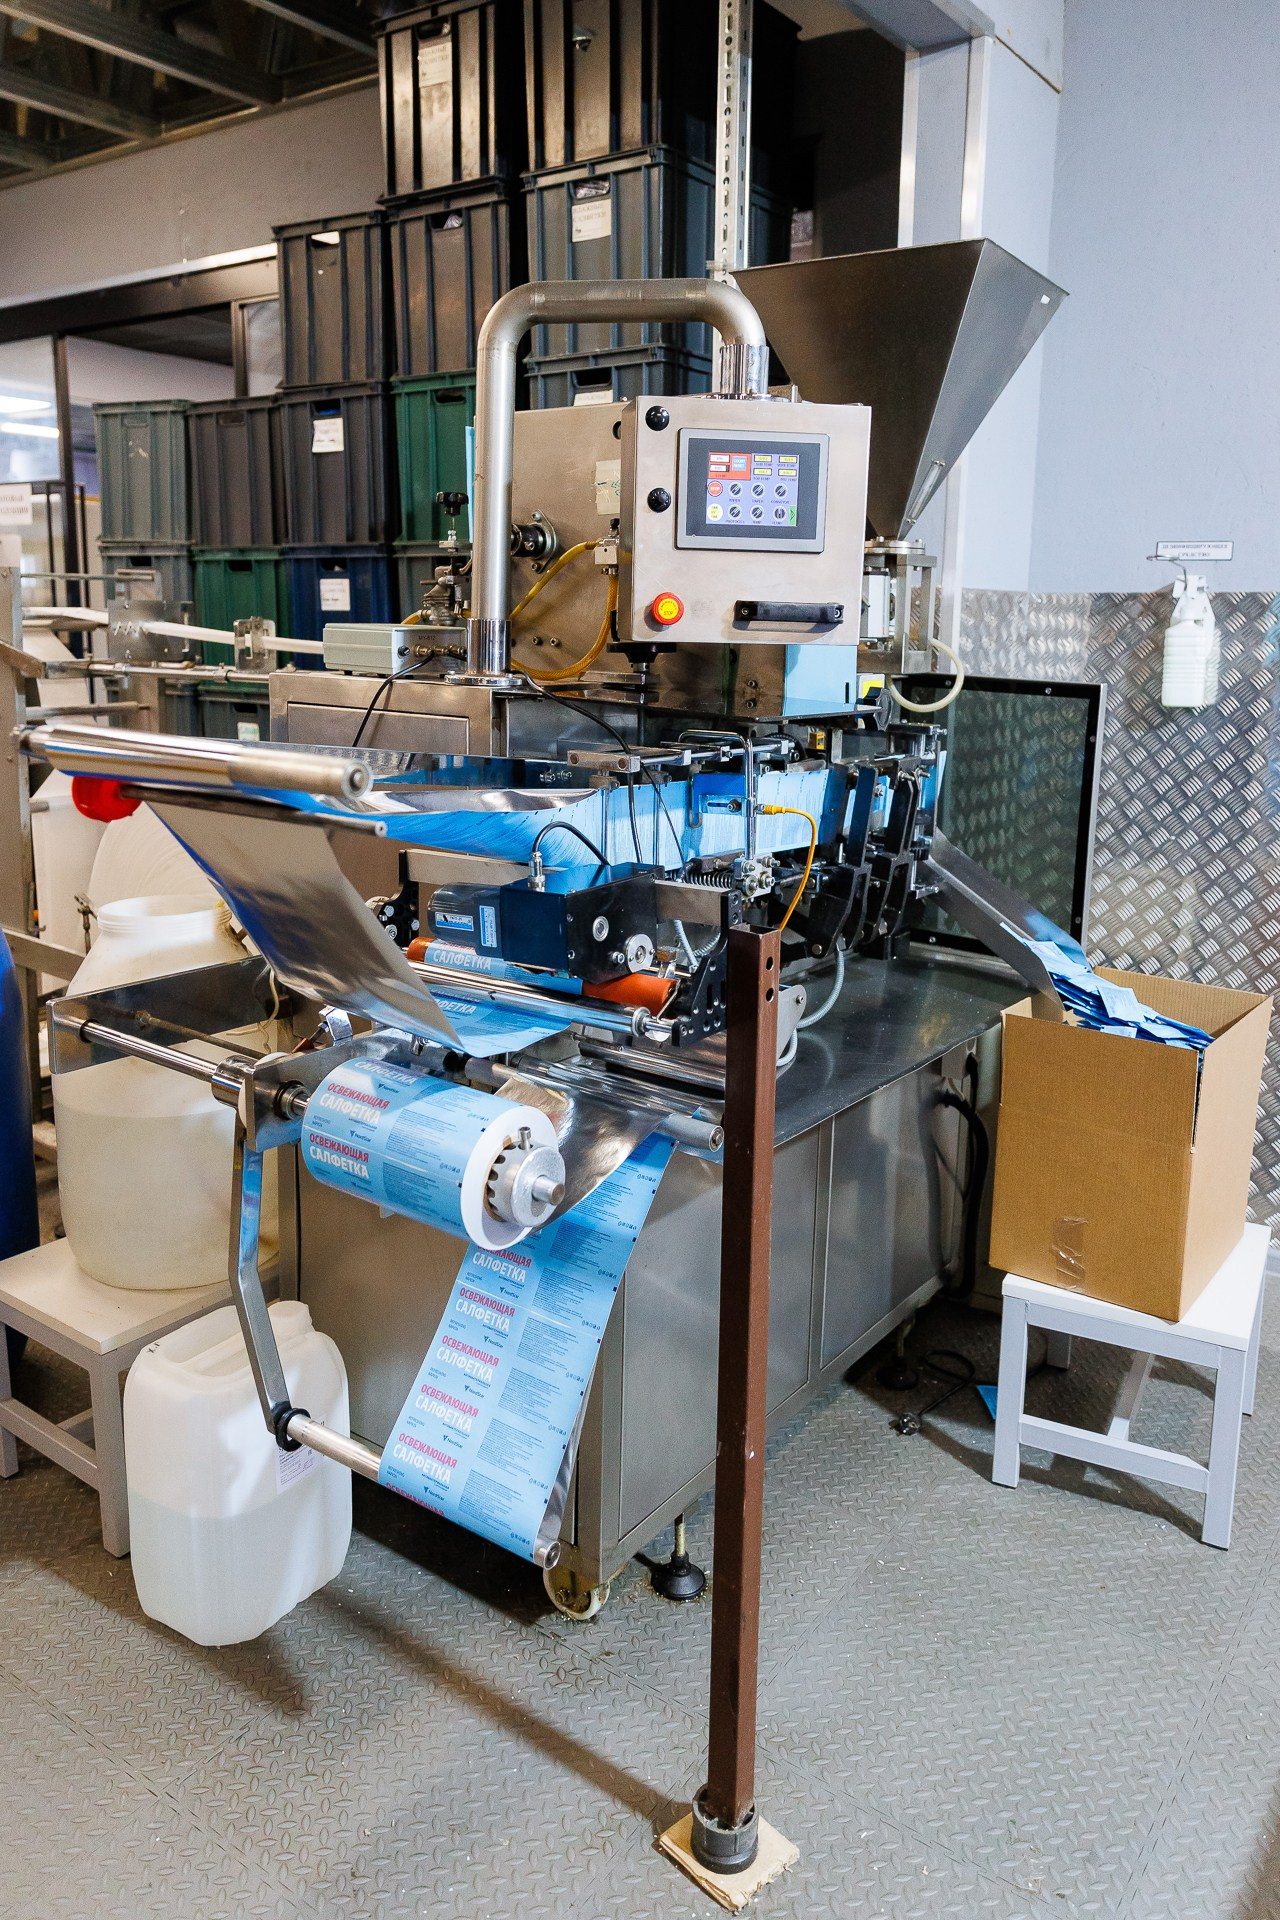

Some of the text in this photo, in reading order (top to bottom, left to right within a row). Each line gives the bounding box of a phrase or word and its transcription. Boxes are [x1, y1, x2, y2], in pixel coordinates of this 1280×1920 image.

[433, 950, 491, 970] САЛФЕТКА
[434, 998, 477, 1014] ФЕТКА
[354, 1061, 417, 1084] САЛФЕТКА
[319, 1094, 382, 1125] САЛФЕТКА
[327, 1083, 391, 1110] ОСВЕЖАЮЩАЯ
[309, 1132, 369, 1163] ОСВЕЖАЮЩАЯ
[309, 1146, 369, 1179] САЛФЕТКА
[473, 1252, 527, 1282] САЛФЕТКА
[455, 1299, 511, 1332] САЛФЕТКА
[459, 1287, 516, 1317] ОСВЕЖАЮЩАЯ
[436, 1346, 494, 1382] САЛФЕТКА
[441, 1335, 500, 1367] ОСВЕЖАЮЩАЯ
[415, 1395, 473, 1432] САЛФЕТКА
[421, 1383, 479, 1418] ОСВЕЖАЮЩАЯ
[393, 1444, 452, 1484] САЛФЕТКА
[398, 1433, 458, 1468] ОСВЕЖАЮЩАЯ
